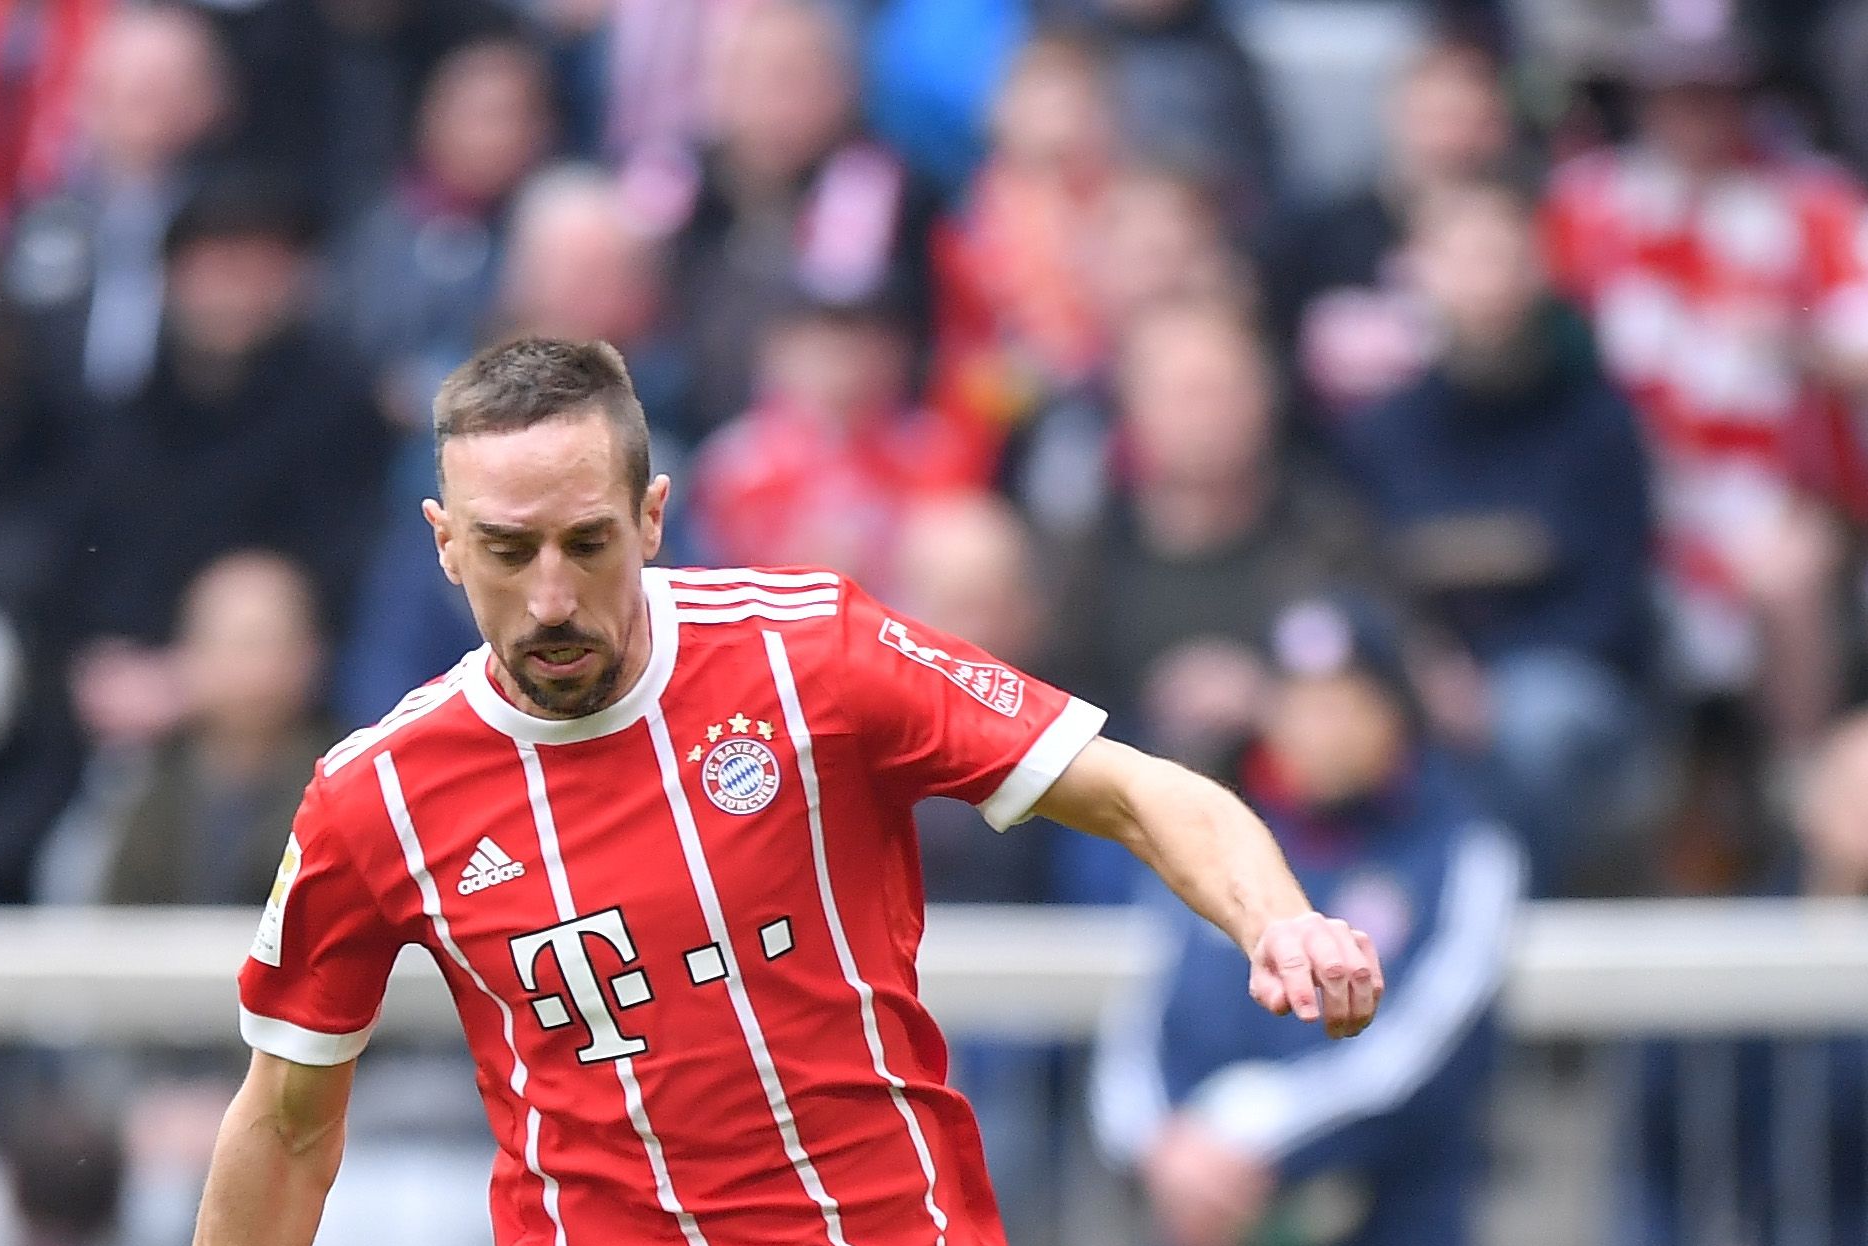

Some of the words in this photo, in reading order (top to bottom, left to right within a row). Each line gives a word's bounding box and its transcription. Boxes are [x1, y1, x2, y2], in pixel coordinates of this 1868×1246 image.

[707, 762, 720, 780] FC
[715, 743, 771, 765] BAYERN
[457, 861, 526, 895] adidas
